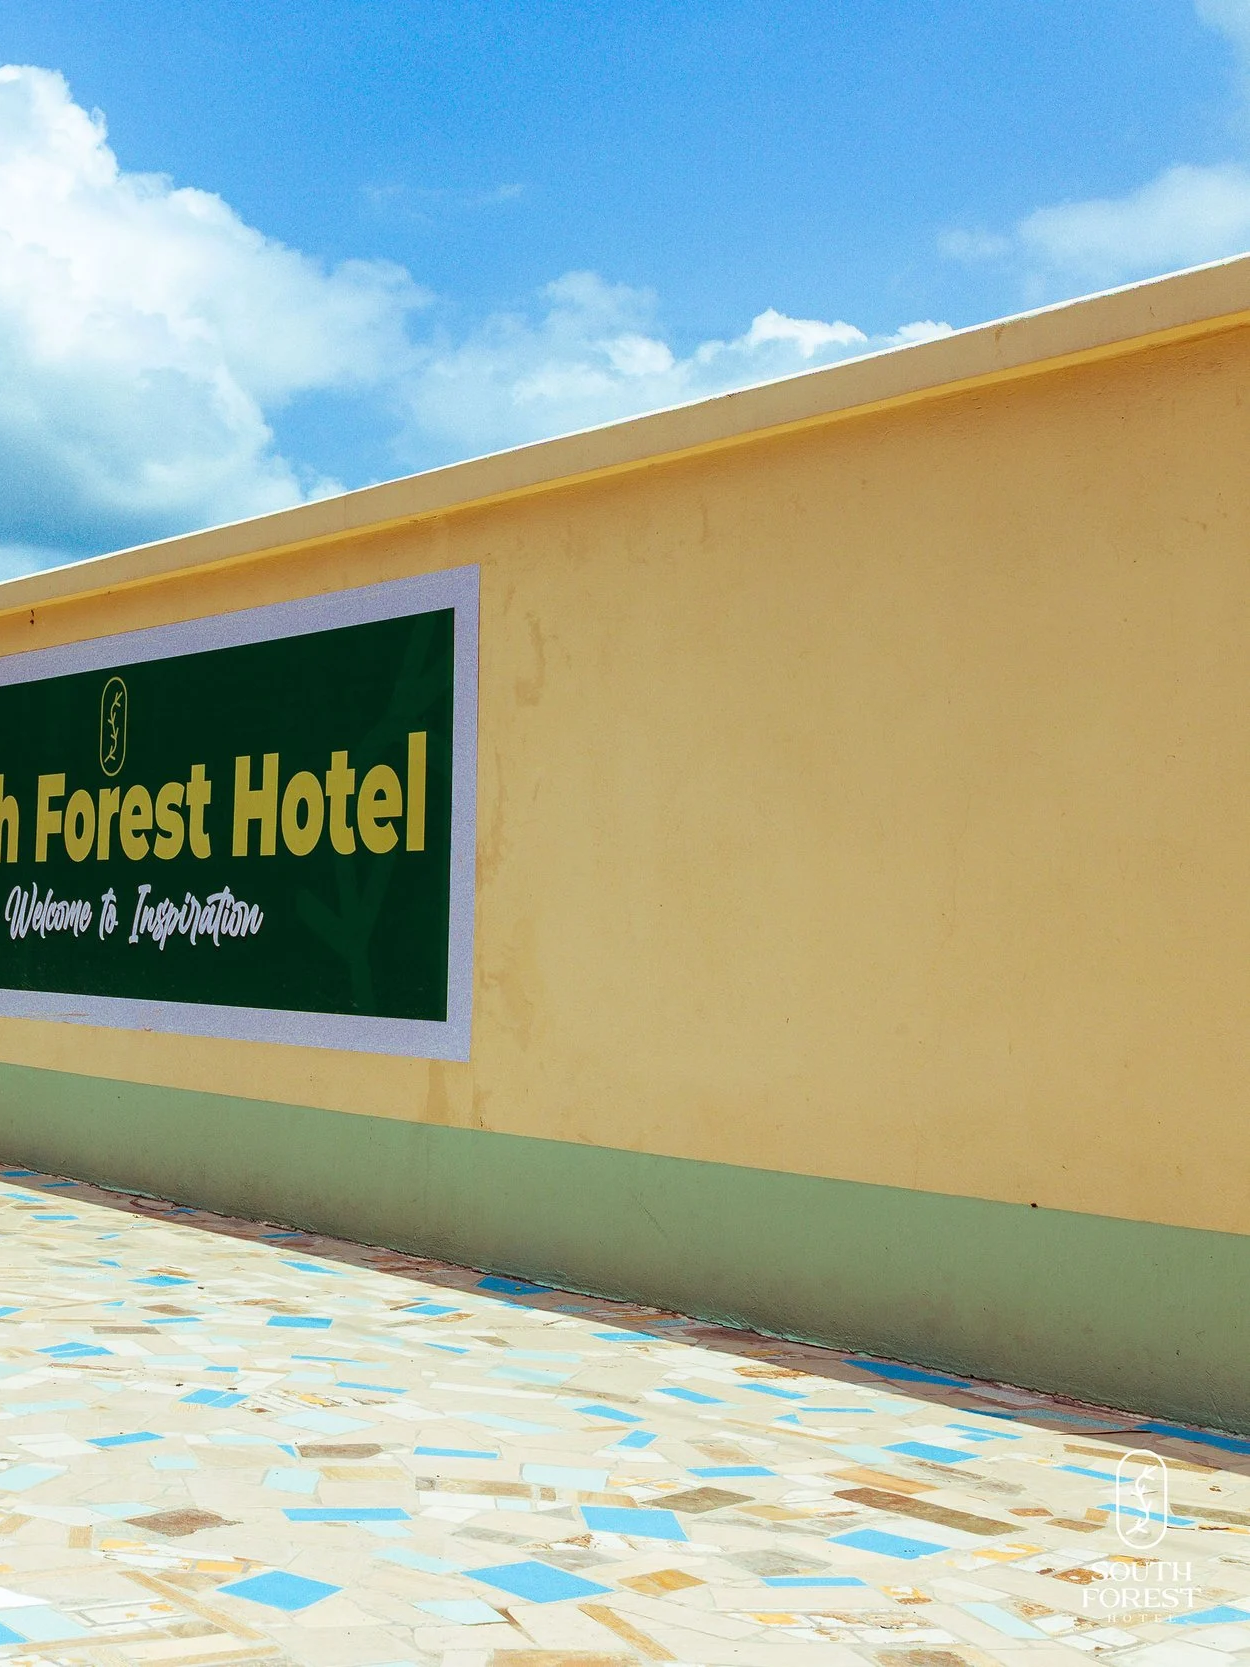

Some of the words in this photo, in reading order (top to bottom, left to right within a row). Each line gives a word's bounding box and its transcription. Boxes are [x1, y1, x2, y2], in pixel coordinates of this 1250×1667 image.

[35, 763, 212, 863] Forest
[232, 731, 427, 857] Hotel
[5, 882, 92, 941] Welcome
[99, 887, 118, 940] to
[128, 884, 264, 951] Inspiration
